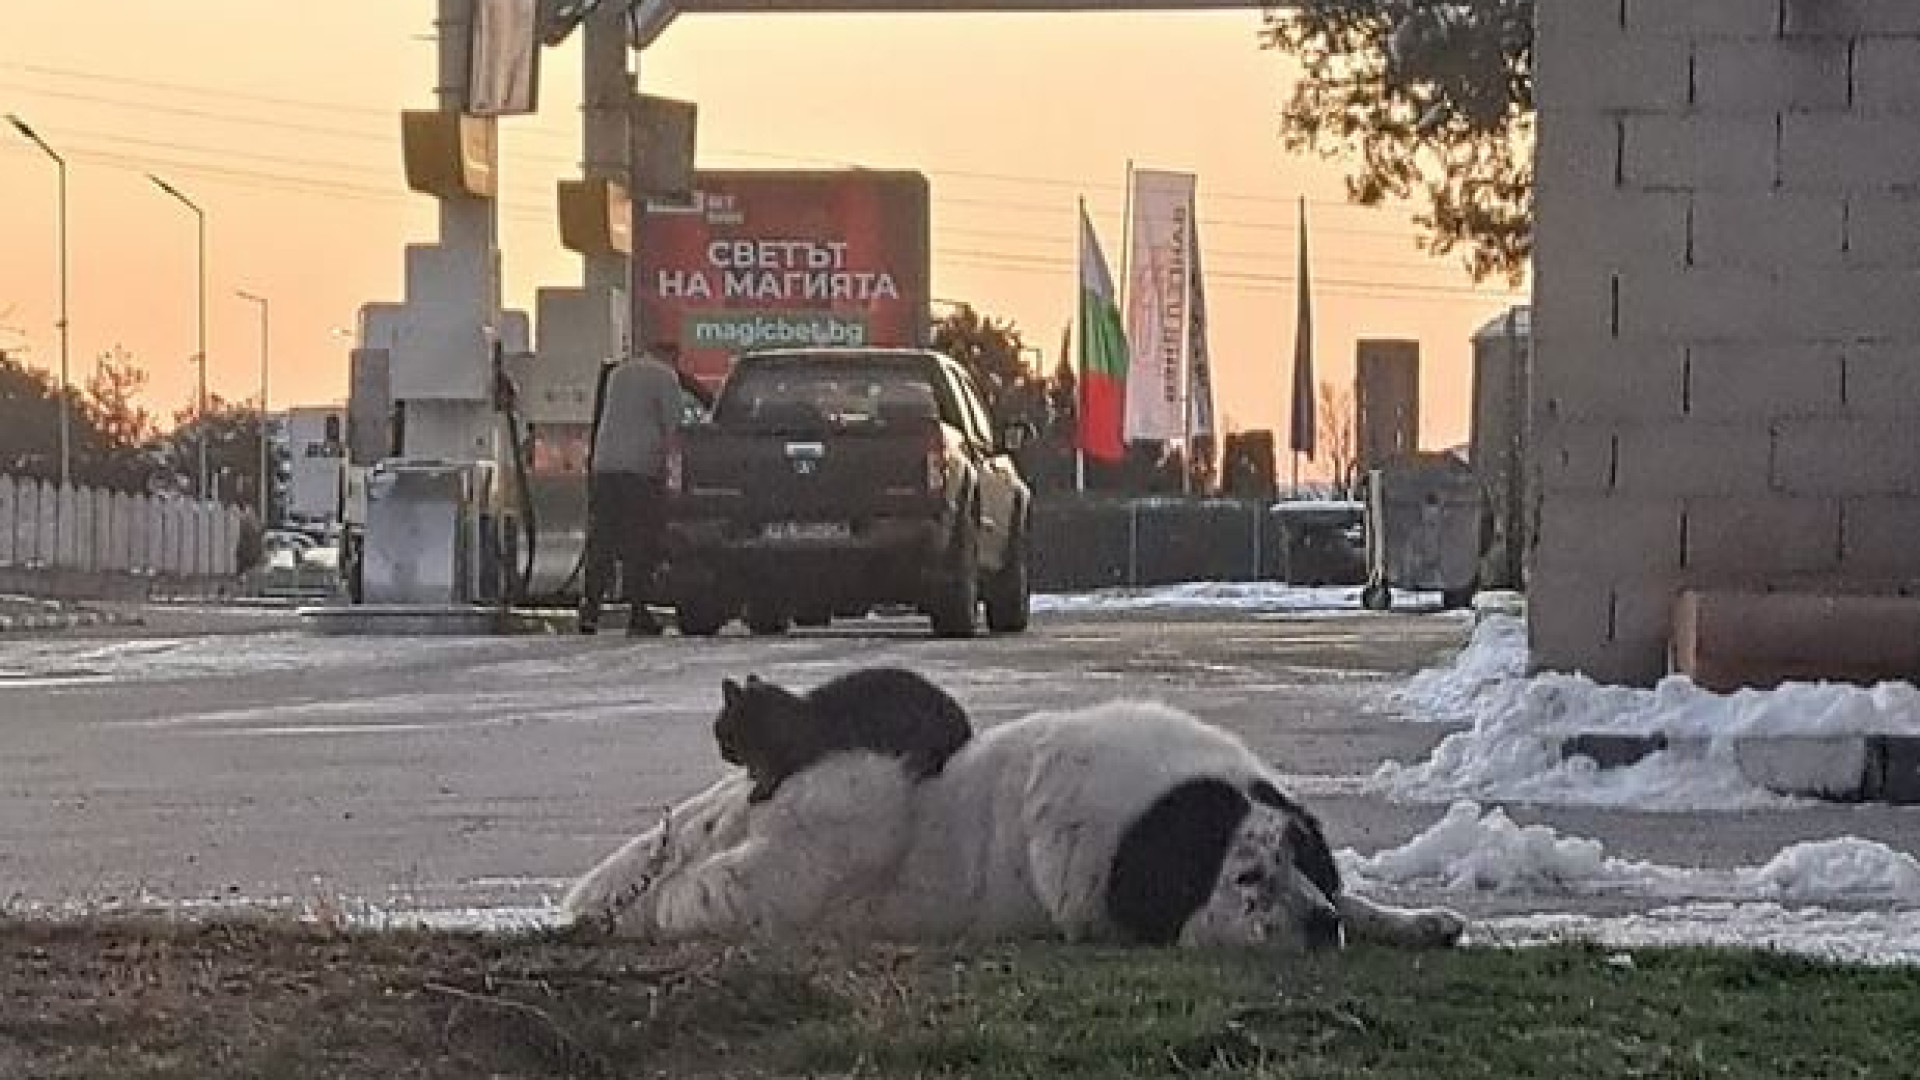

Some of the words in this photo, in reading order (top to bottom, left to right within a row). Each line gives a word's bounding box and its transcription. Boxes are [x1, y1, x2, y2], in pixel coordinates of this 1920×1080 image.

[709, 240, 847, 268] СВЕТЪТ
[659, 271, 710, 298] НА
[724, 272, 898, 300] МАГИЯТА
[695, 317, 863, 345] magicbet.bg
